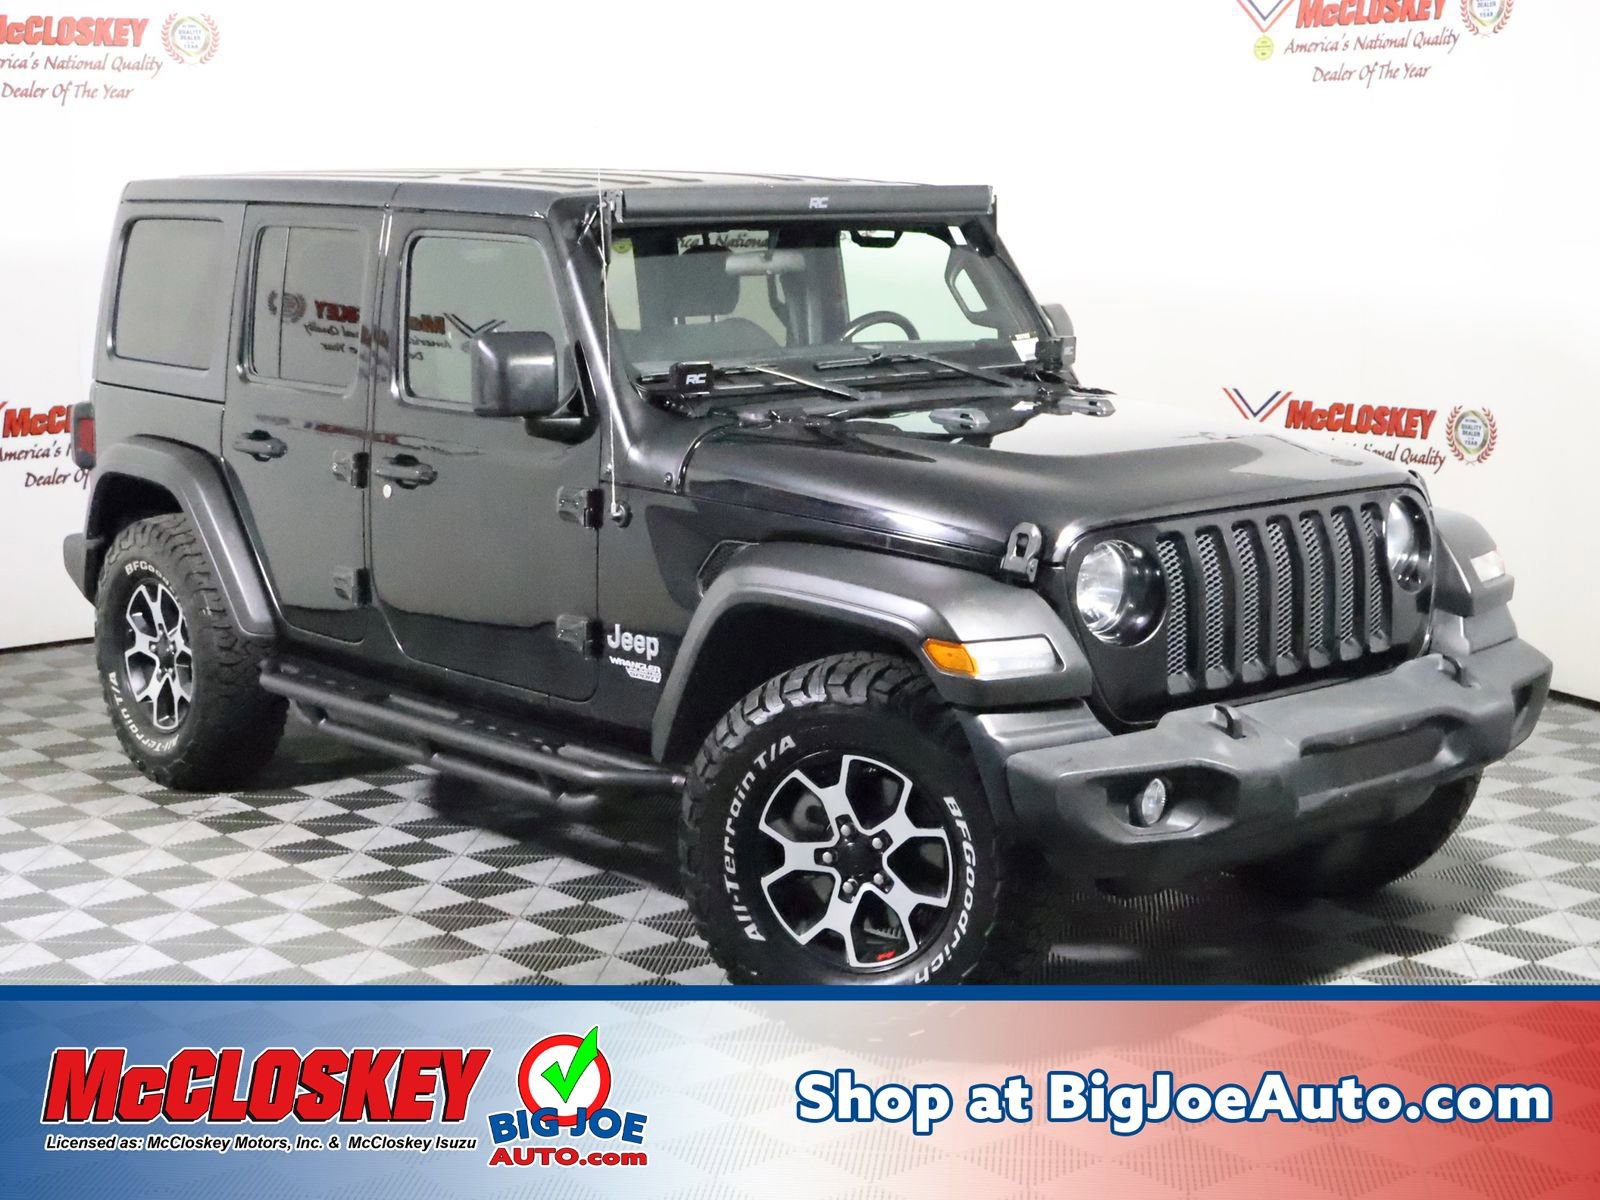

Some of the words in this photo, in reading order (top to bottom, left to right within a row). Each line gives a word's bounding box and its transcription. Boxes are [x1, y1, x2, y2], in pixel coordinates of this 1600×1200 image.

[1284, 33, 1350, 55] America's
[1353, 29, 1412, 51] National
[1413, 26, 1460, 54] Quality
[44, 52, 107, 71] National
[111, 54, 163, 79] Quality
[1312, 63, 1357, 82] Dealer
[1358, 61, 1379, 89] Of
[1379, 60, 1400, 80] The
[1403, 62, 1432, 80] Year
[1, 81, 49, 98] Dealer
[52, 81, 73, 106] Of
[74, 82, 99, 98] The
[103, 84, 134, 99] Year
[808, 197, 829, 209] RC
[685, 372, 707, 385] RC
[1285, 399, 1437, 440] McCLOSKEY
[1400, 446, 1447, 474] Quality
[25, 467, 71, 488] Dealer
[607, 623, 659, 661] Jeep
[723, 771, 767, 942] All-Terrain
[754, 735, 797, 771] T/A
[914, 796, 977, 984] BFGoodrich
